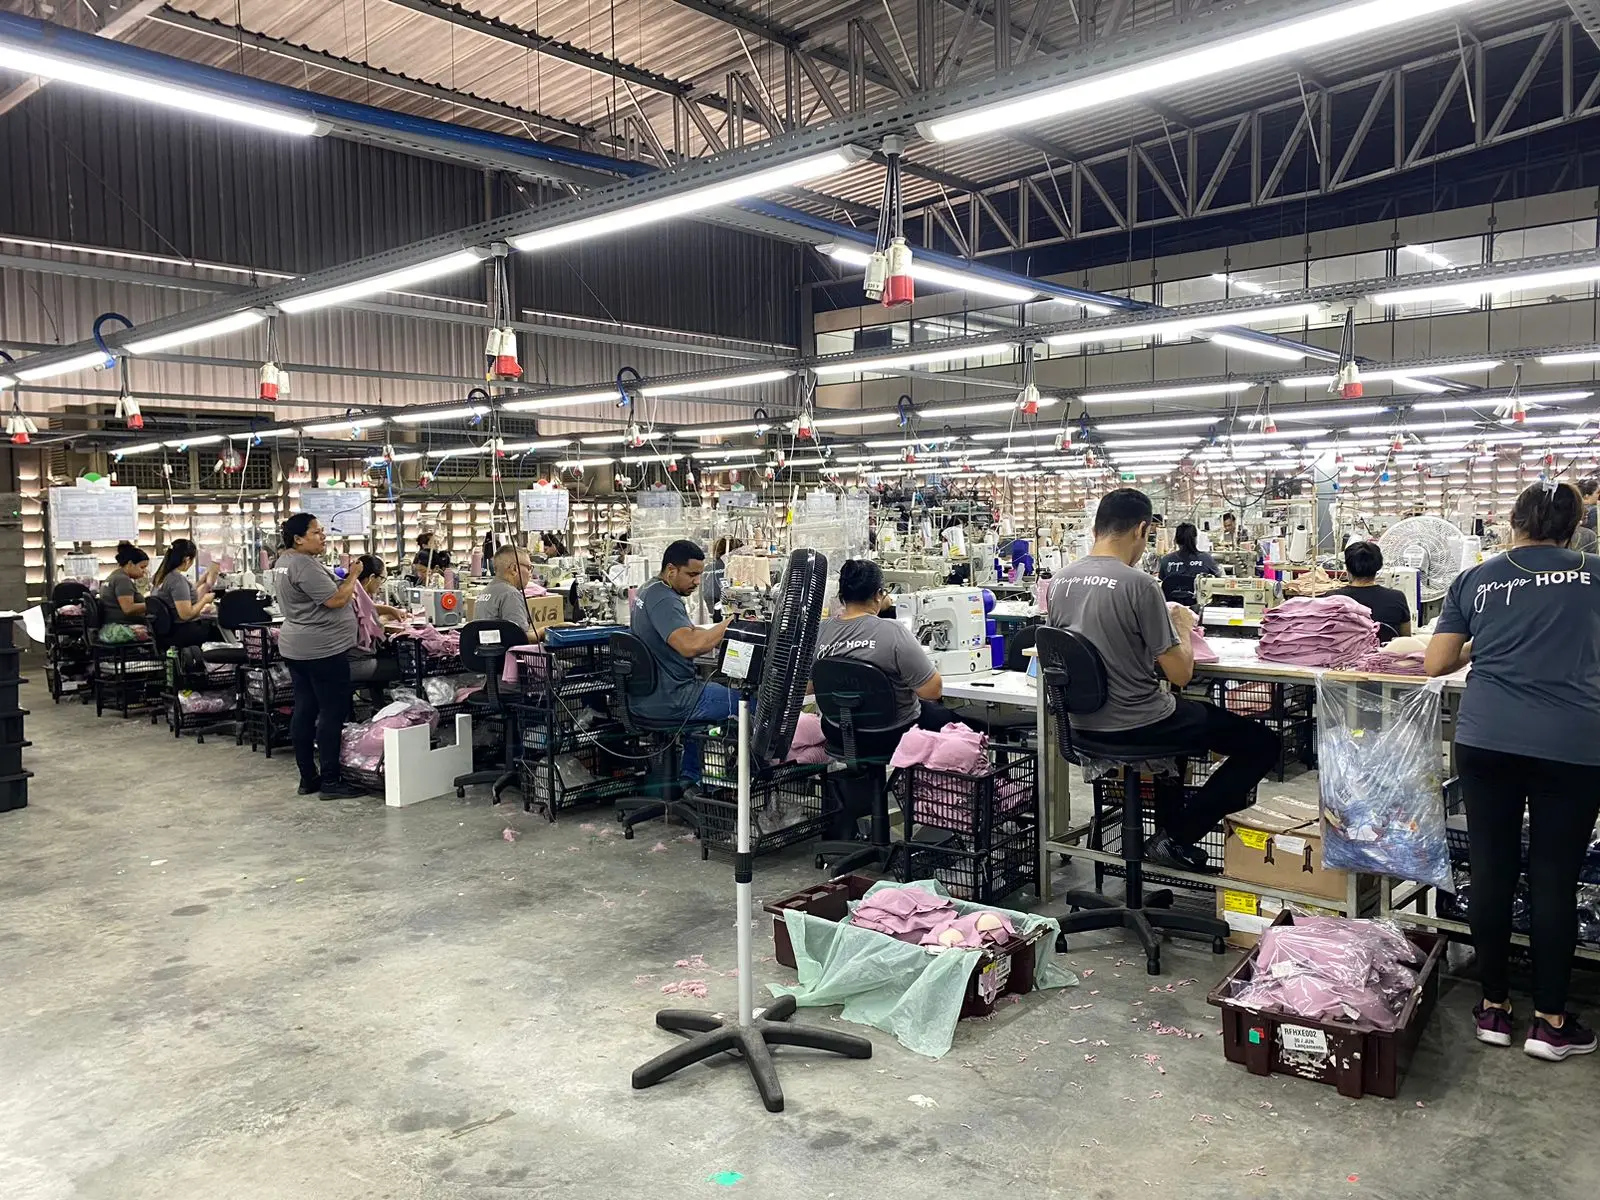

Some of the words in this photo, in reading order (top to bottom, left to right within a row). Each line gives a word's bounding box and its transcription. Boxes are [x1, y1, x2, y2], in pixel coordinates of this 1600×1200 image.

[1050, 576, 1082, 601] grupo
[1082, 575, 1118, 590] HOPE
[1474, 578, 1532, 613] grupo
[1535, 571, 1591, 587] HOPE
[846, 640, 877, 649] HOPE
